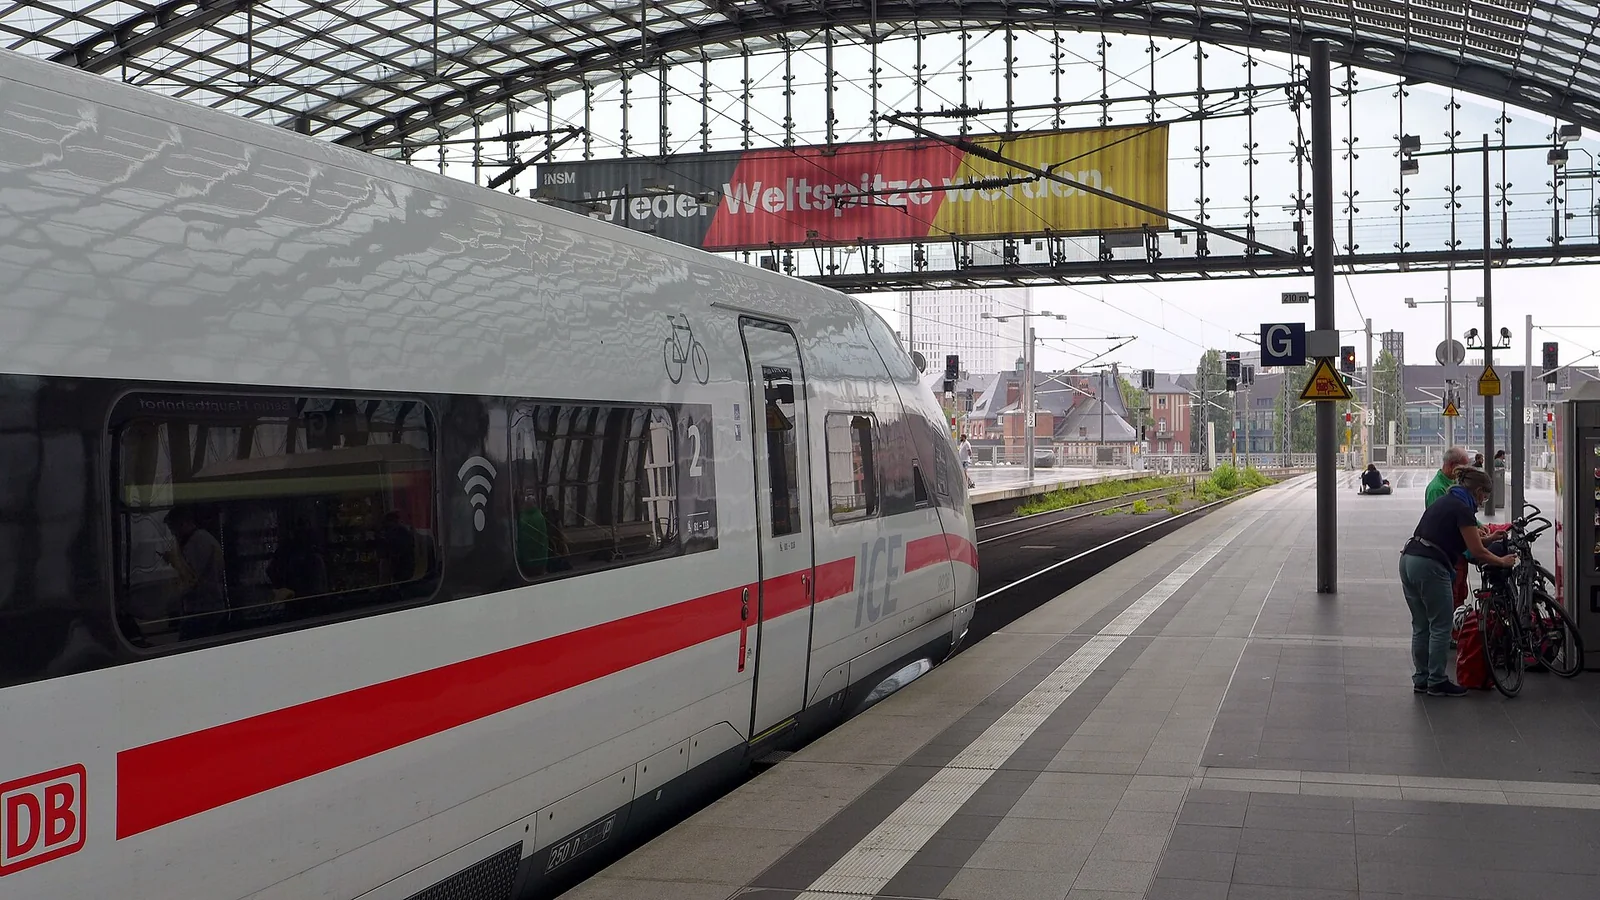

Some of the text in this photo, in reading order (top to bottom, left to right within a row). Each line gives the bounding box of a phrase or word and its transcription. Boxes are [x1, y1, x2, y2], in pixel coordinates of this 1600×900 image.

[544, 172, 576, 185] INSM
[722, 172, 933, 218] Weltspitze
[1283, 294, 1297, 302] 210
[1266, 324, 1292, 357] G
[687, 425, 702, 477] 2
[854, 534, 902, 629] ICE
[7, 782, 76, 859] DB
[548, 842, 570, 869] 250
